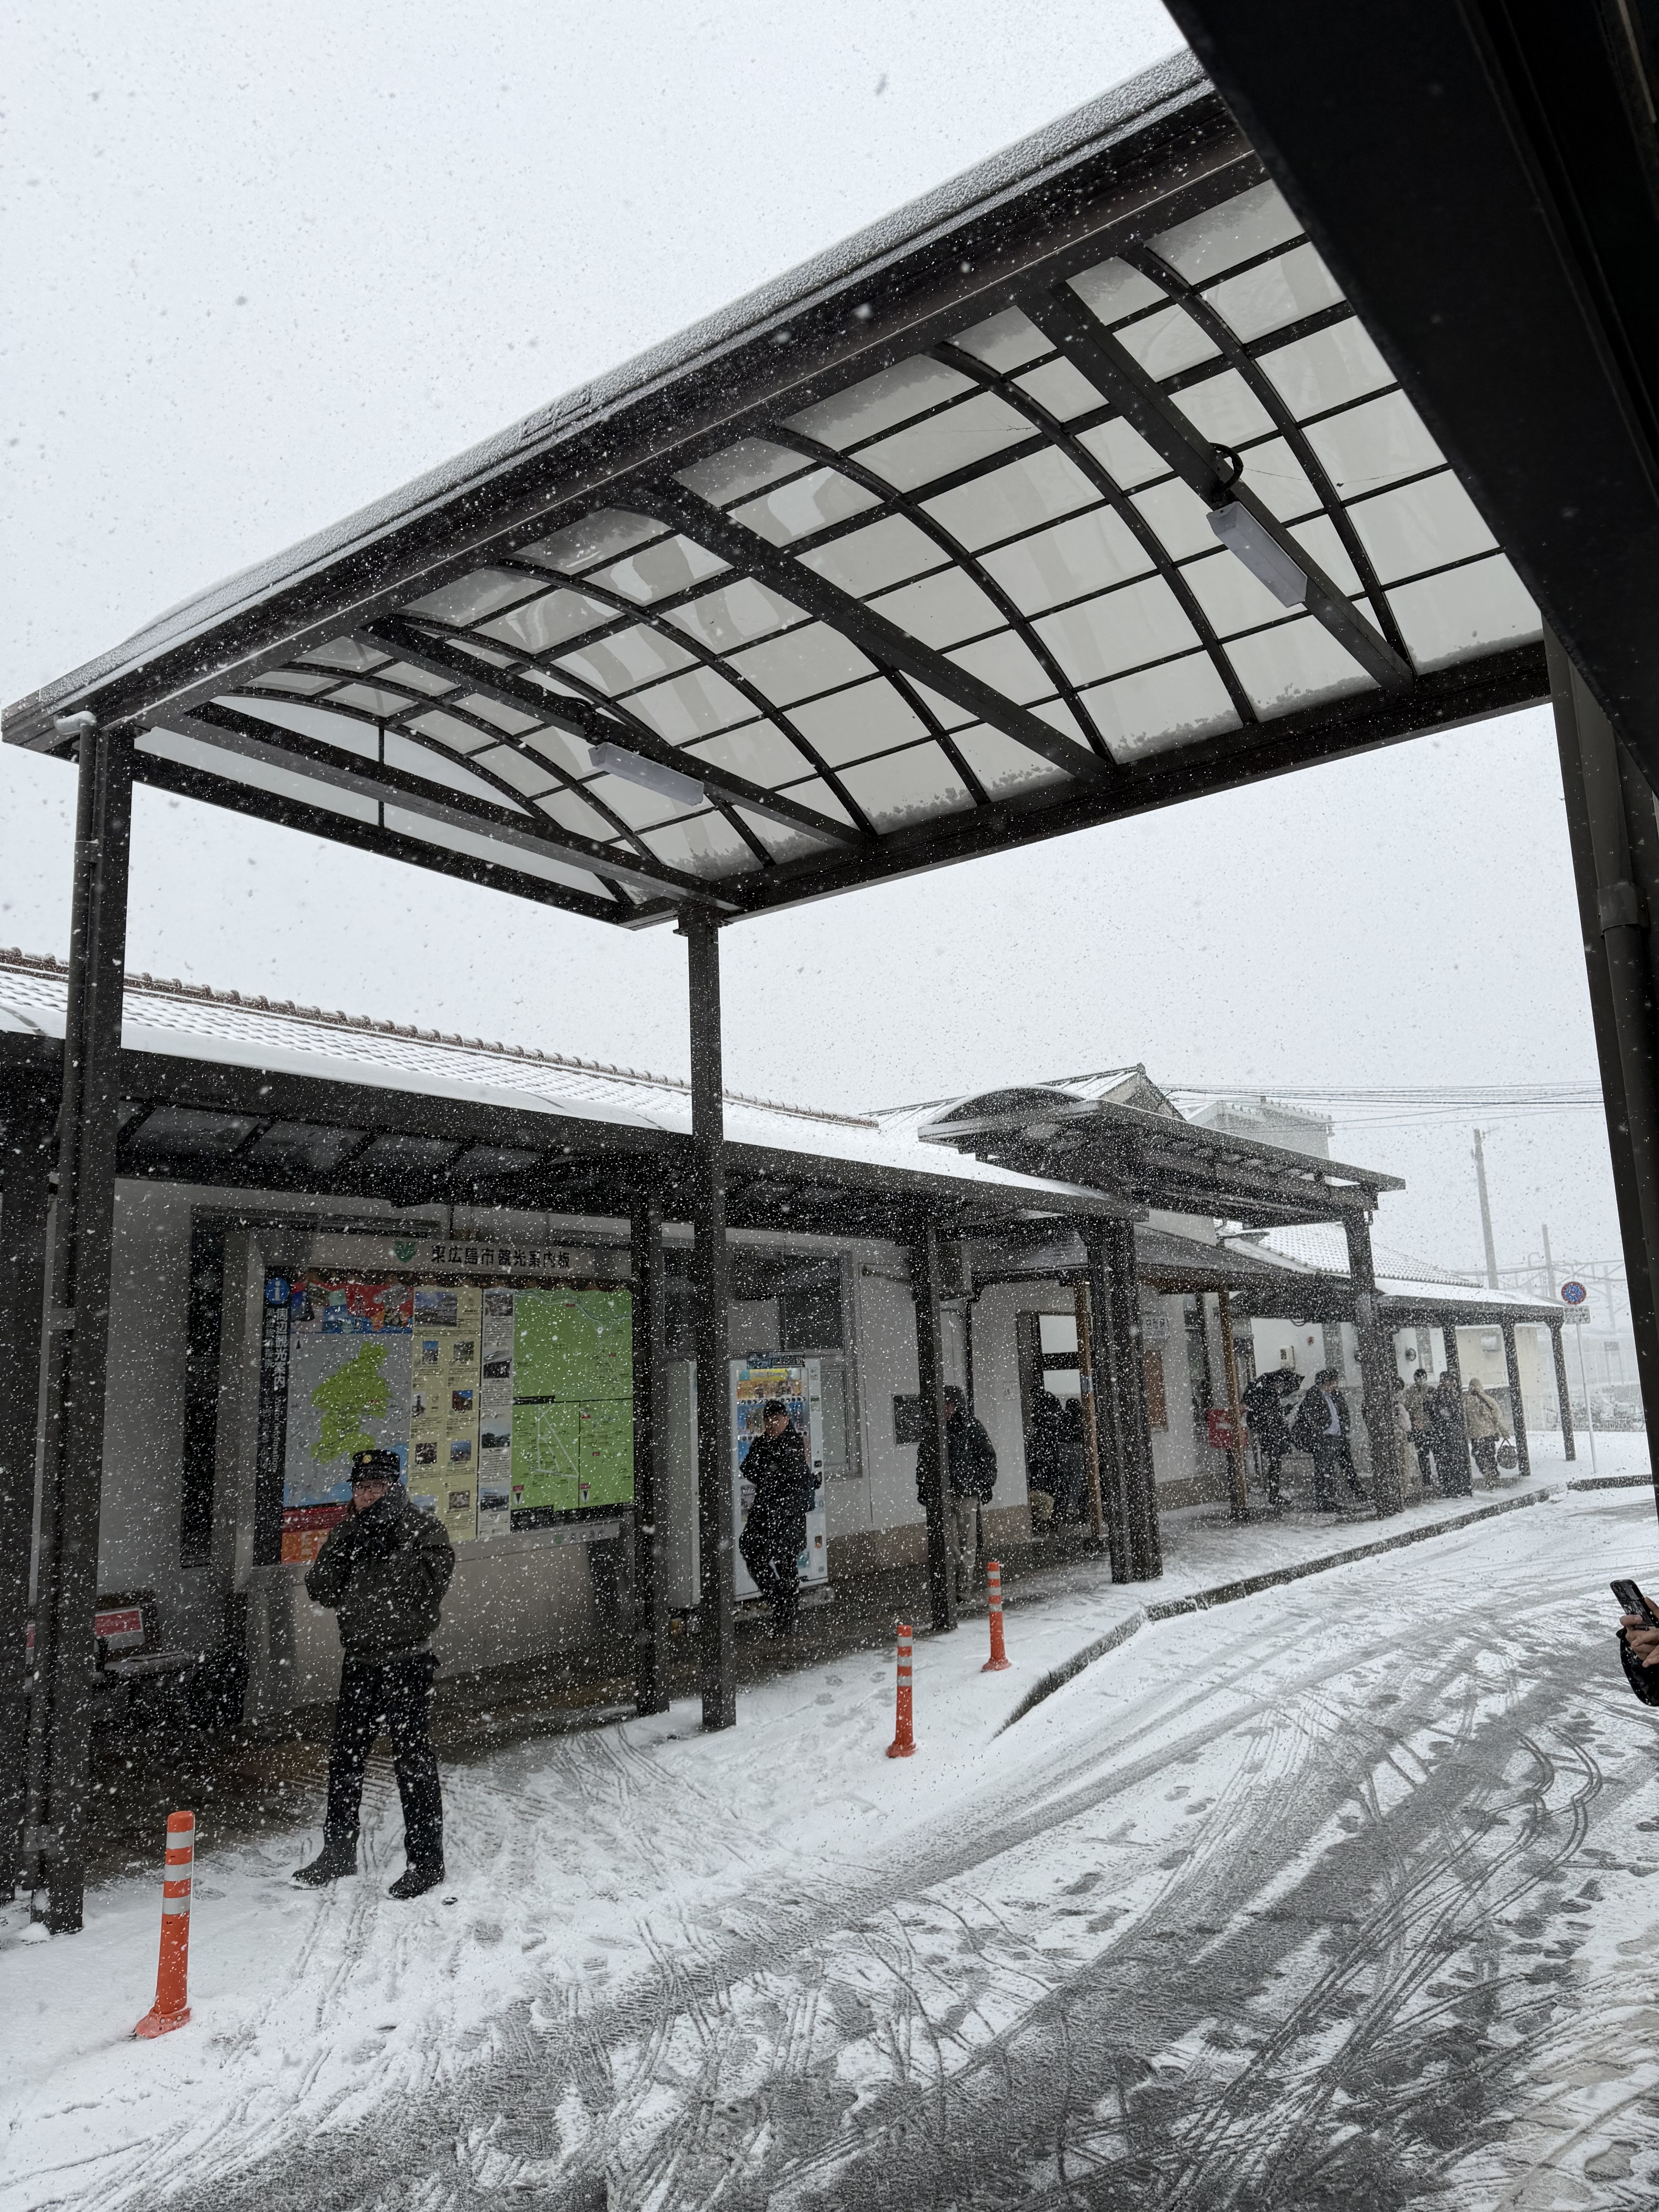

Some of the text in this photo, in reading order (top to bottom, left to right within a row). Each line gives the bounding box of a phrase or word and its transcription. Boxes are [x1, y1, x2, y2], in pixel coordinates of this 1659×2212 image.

[431, 1245, 570, 1269] 東広島市観光案内板
[272, 1423, 281, 1472] Information
